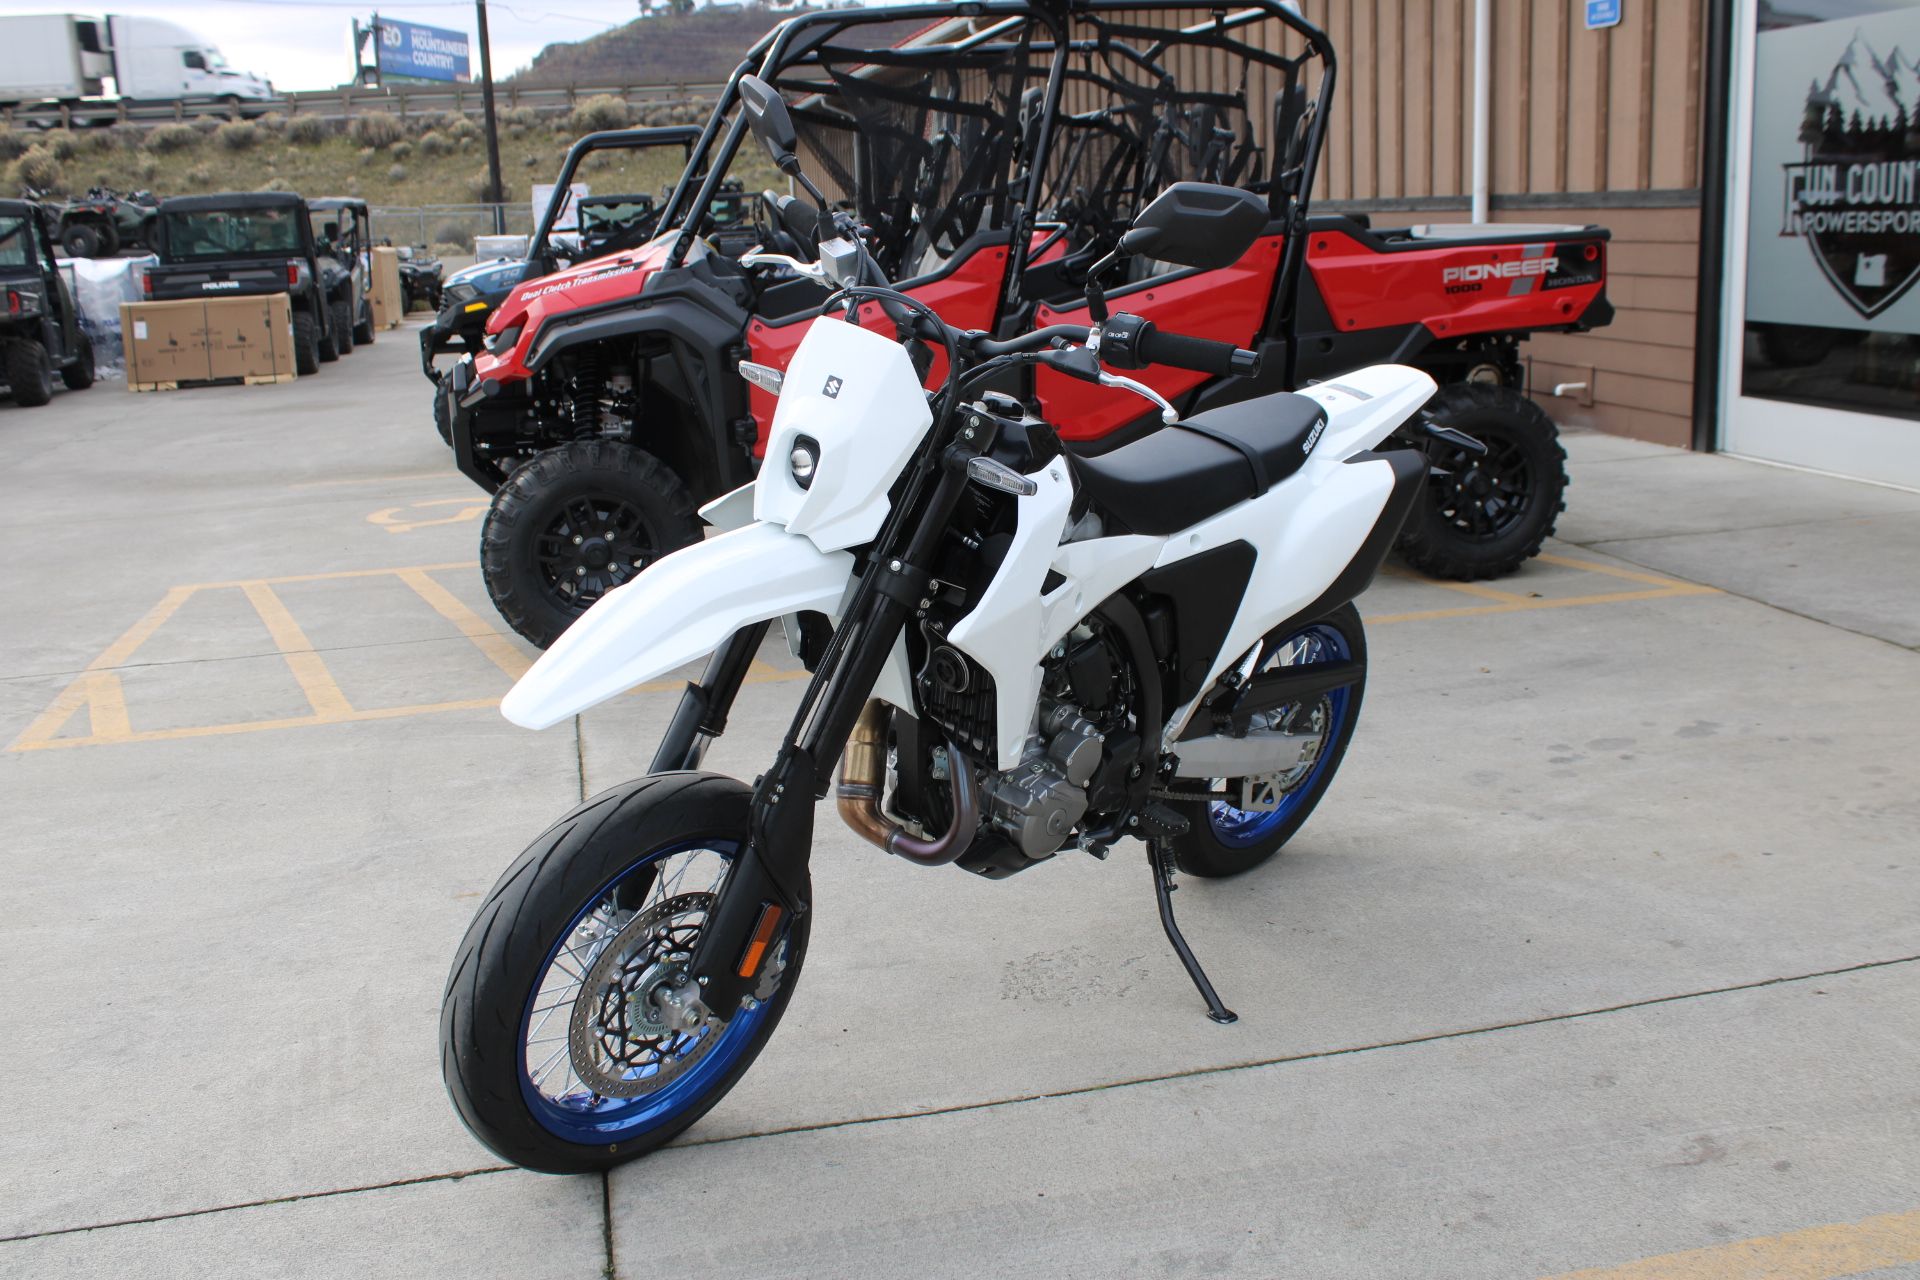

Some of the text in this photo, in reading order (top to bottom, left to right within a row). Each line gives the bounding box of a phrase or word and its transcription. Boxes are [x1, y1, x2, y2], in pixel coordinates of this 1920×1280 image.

[410, 34, 469, 58] MOUNTAINEER
[1443, 257, 1559, 284] PIONEER
[1548, 274, 1595, 288] HONDA
[202, 280, 240, 290] POLARIS
[520, 265, 635, 301] Dual Clutch Transmission
[1445, 283, 1482, 294] 1000
[1302, 417, 1325, 455] SUZUKI
